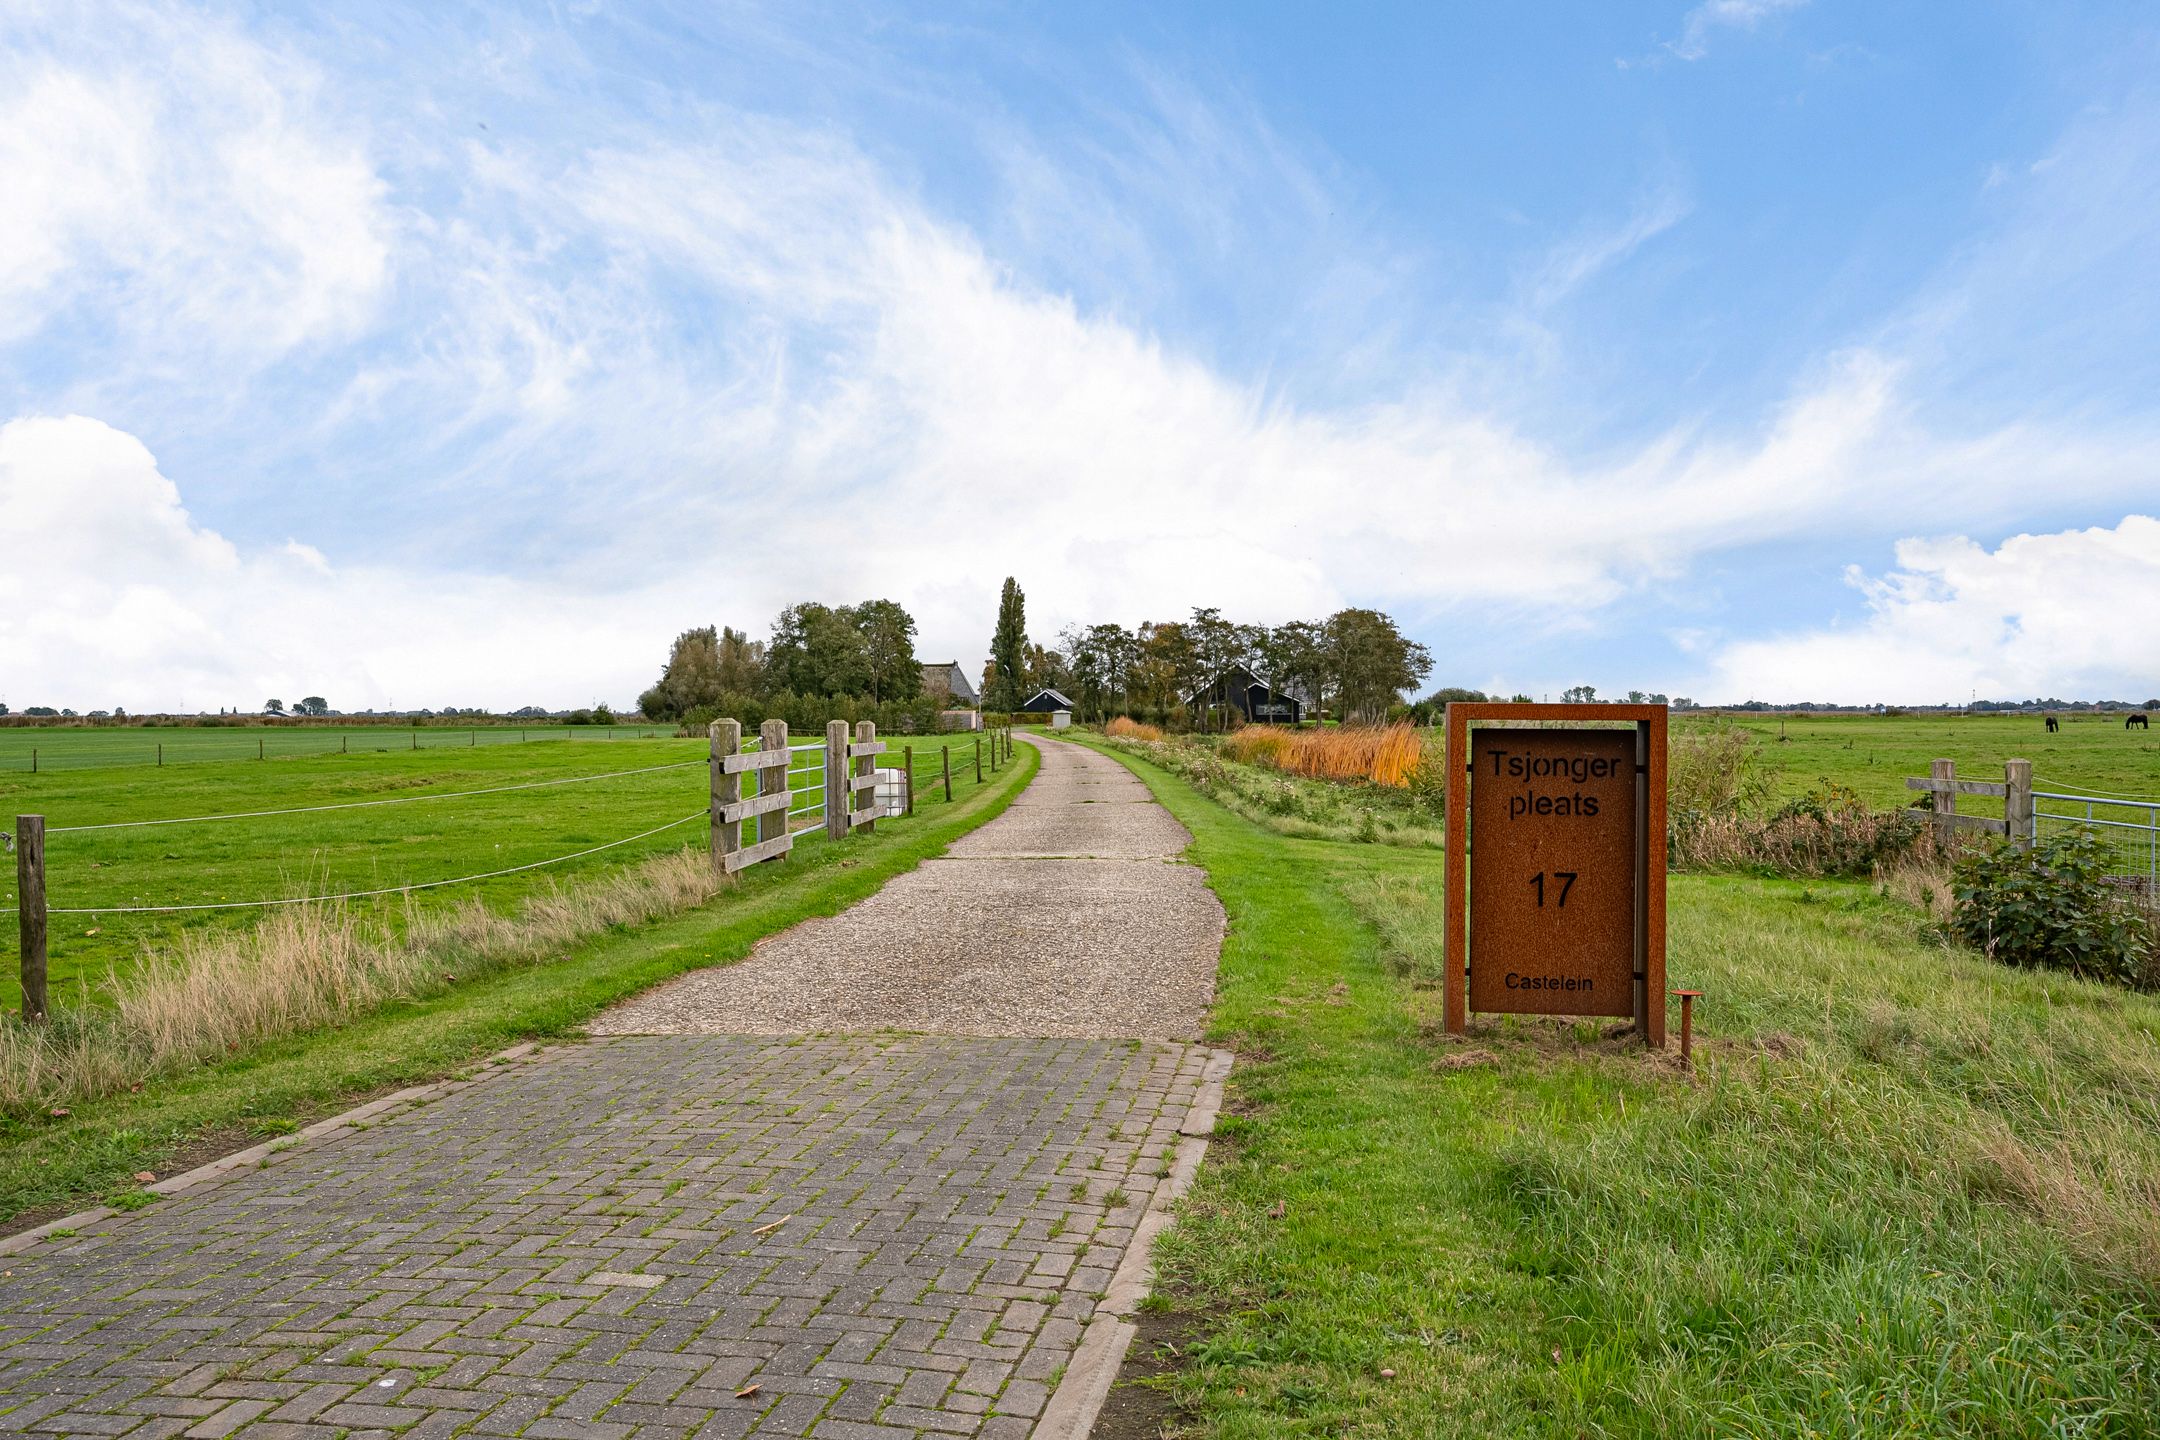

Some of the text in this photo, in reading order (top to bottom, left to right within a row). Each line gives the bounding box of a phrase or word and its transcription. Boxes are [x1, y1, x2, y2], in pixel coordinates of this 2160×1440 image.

[1487, 750, 1621, 783] Tsjonger
[1509, 790, 1599, 820] pleats
[1529, 871, 1577, 907] 17
[1505, 972, 1593, 991] Castelein
